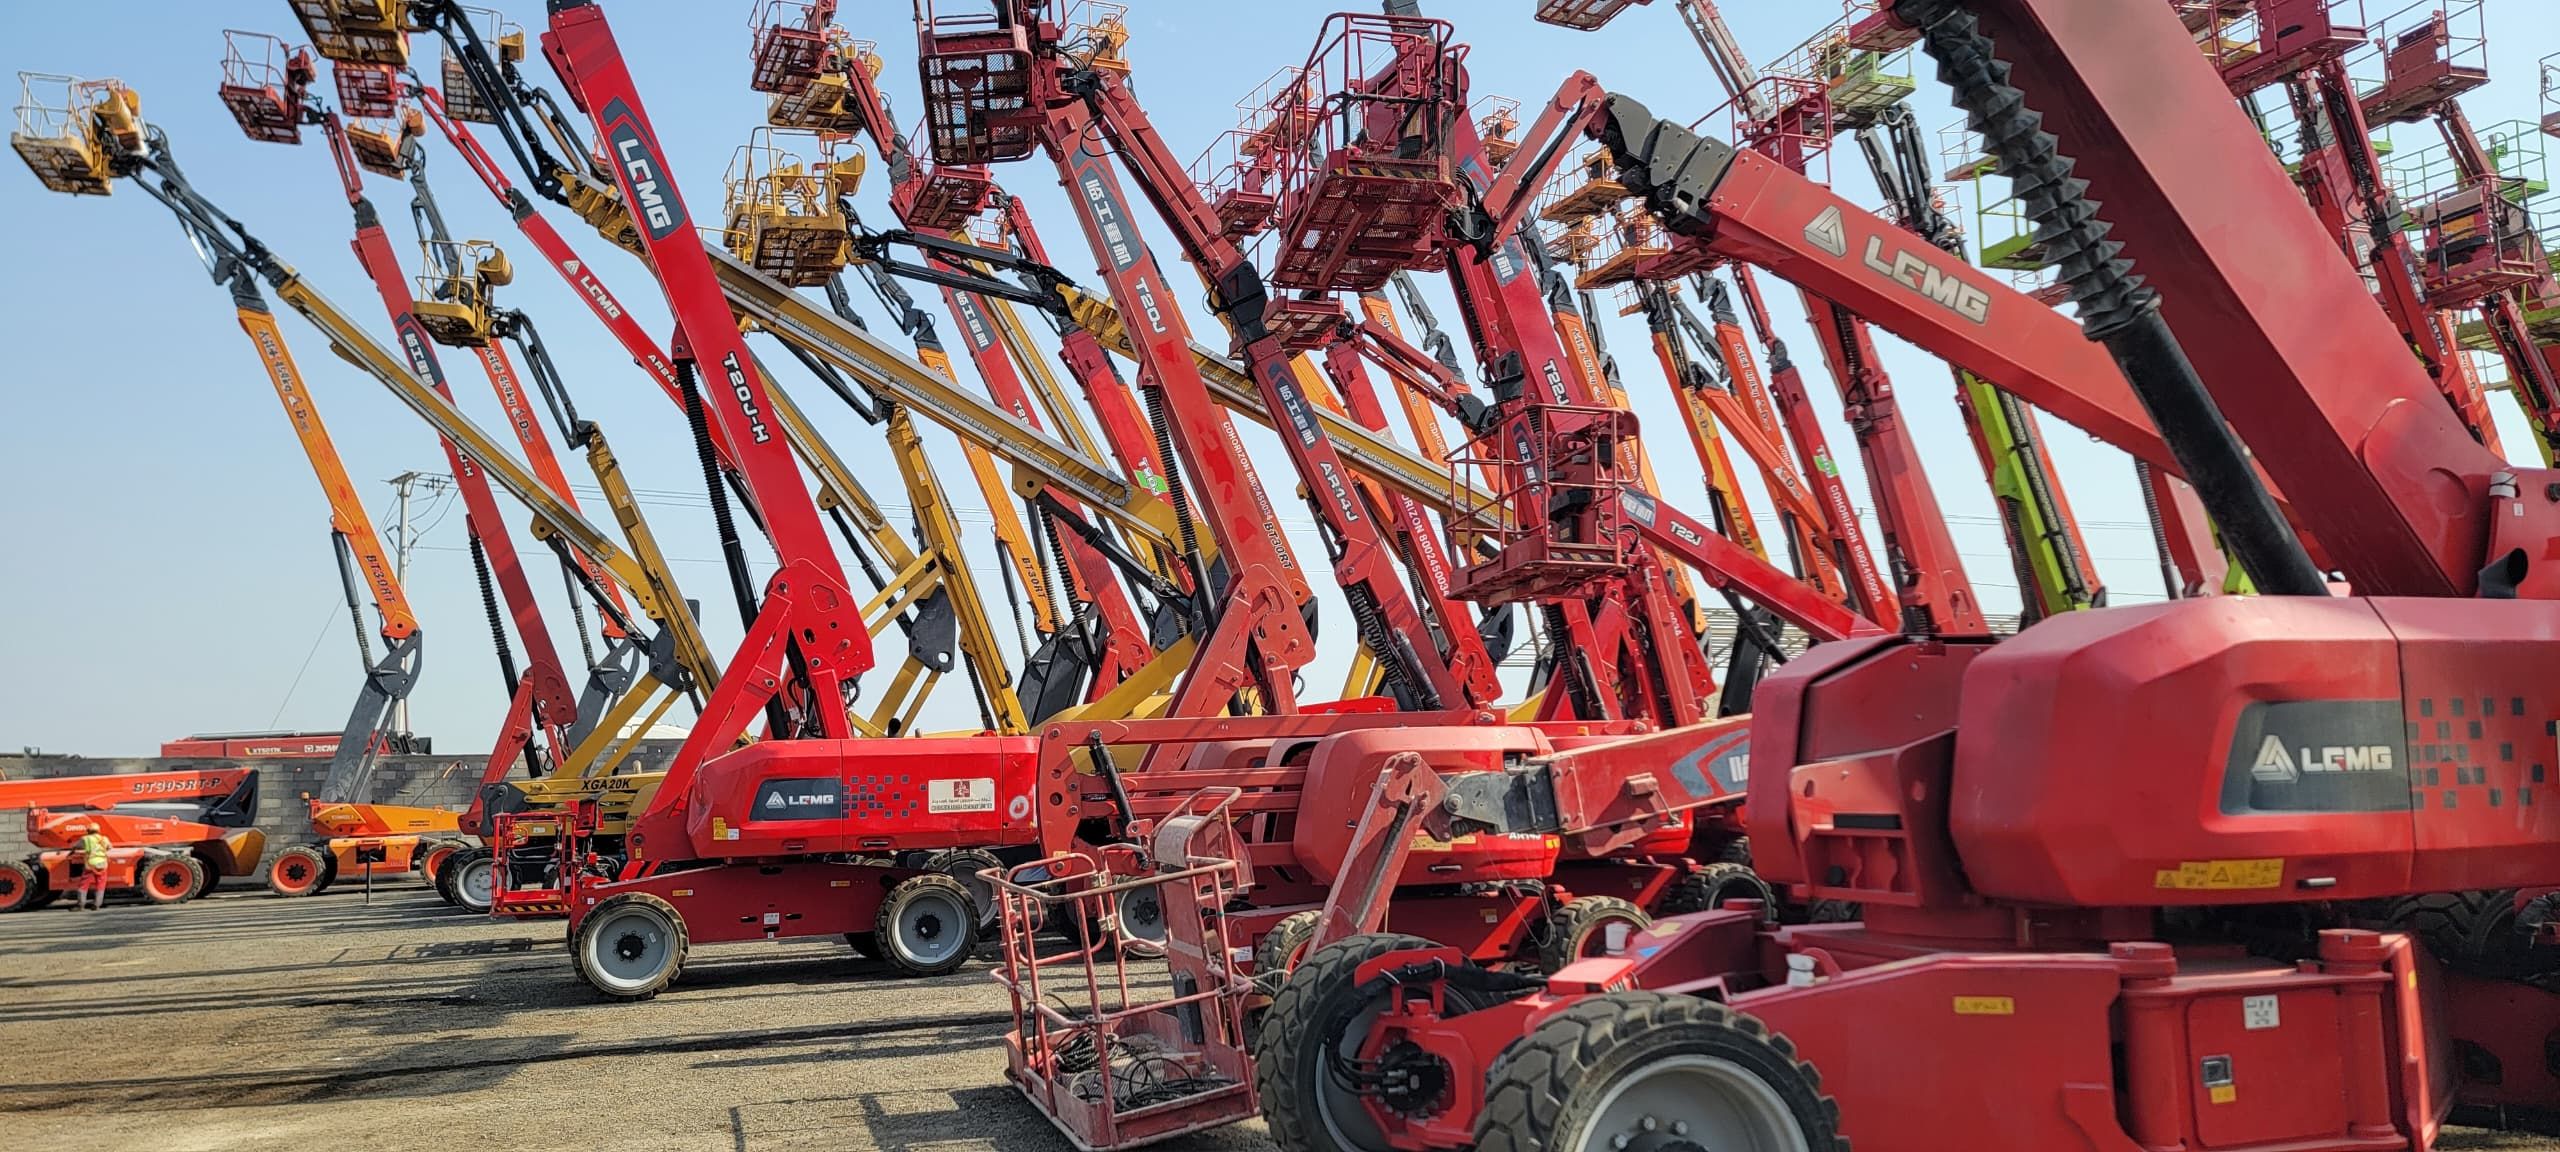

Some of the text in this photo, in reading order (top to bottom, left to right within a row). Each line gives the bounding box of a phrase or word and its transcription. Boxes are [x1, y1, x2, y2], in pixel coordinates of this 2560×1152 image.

[1135, 276, 1167, 334] T20J
[722, 352, 770, 444] T20J-H
[1319, 462, 1360, 522] AR14J
[1264, 522, 1294, 569] BT30RT
[1669, 520, 1703, 546] T22J
[581, 778, 631, 791] XGA20K
